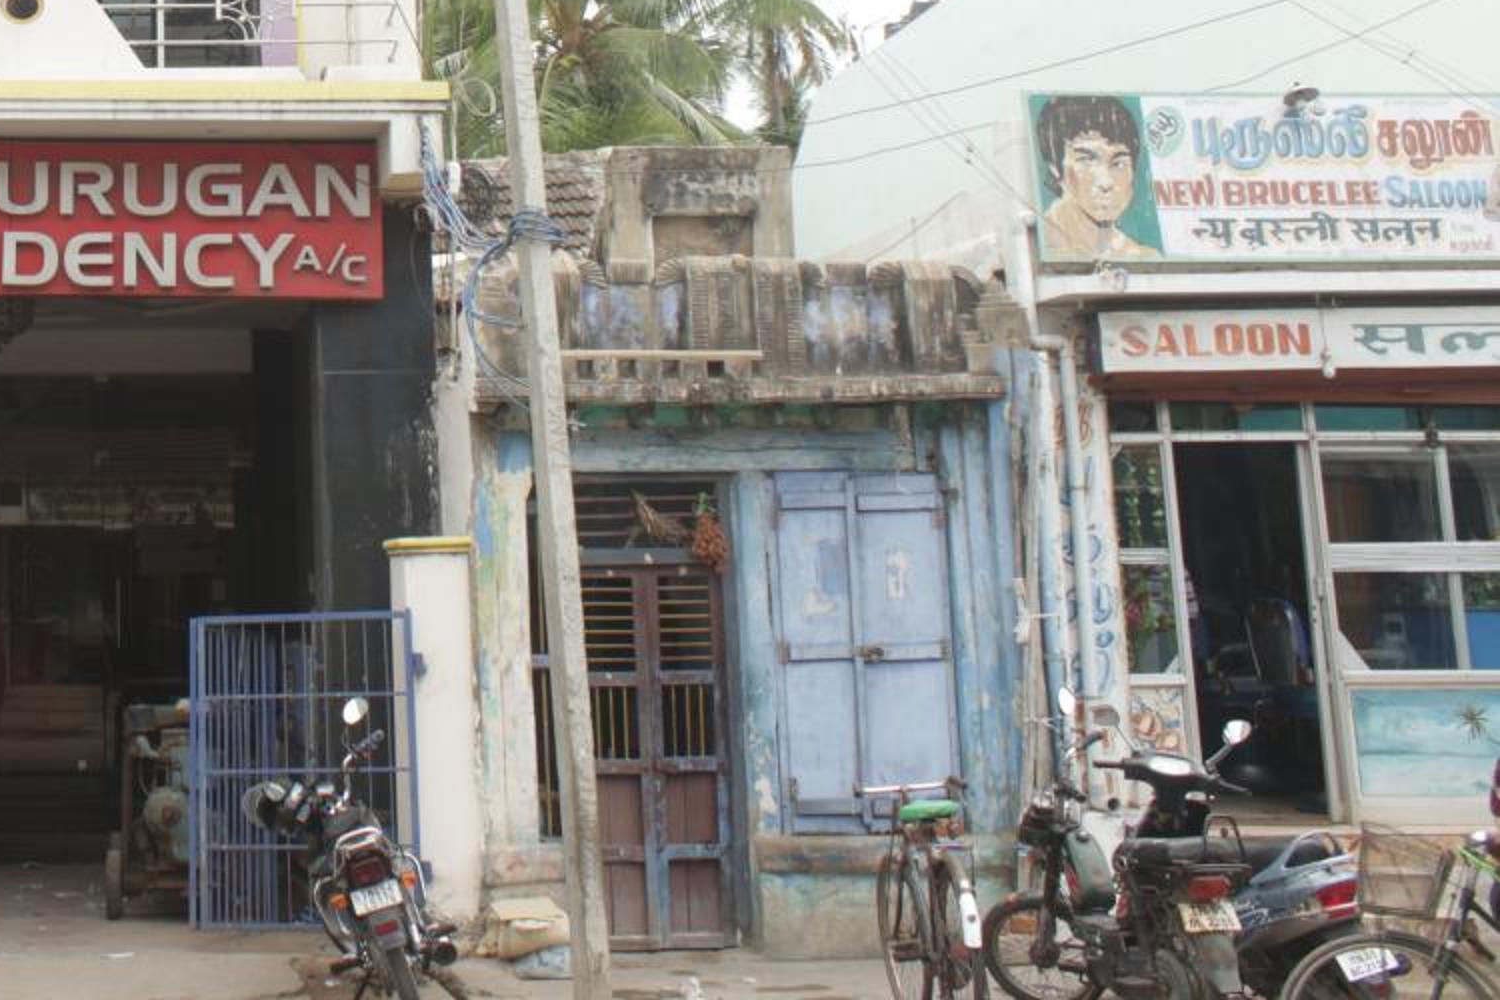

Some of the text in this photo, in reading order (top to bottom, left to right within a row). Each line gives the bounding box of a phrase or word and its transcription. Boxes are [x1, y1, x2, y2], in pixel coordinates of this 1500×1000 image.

[1154, 175, 1487, 208] NEW BRUCELEE SALOON
[293, 242, 367, 283] A/C
[1119, 323, 1312, 357] SALOON
